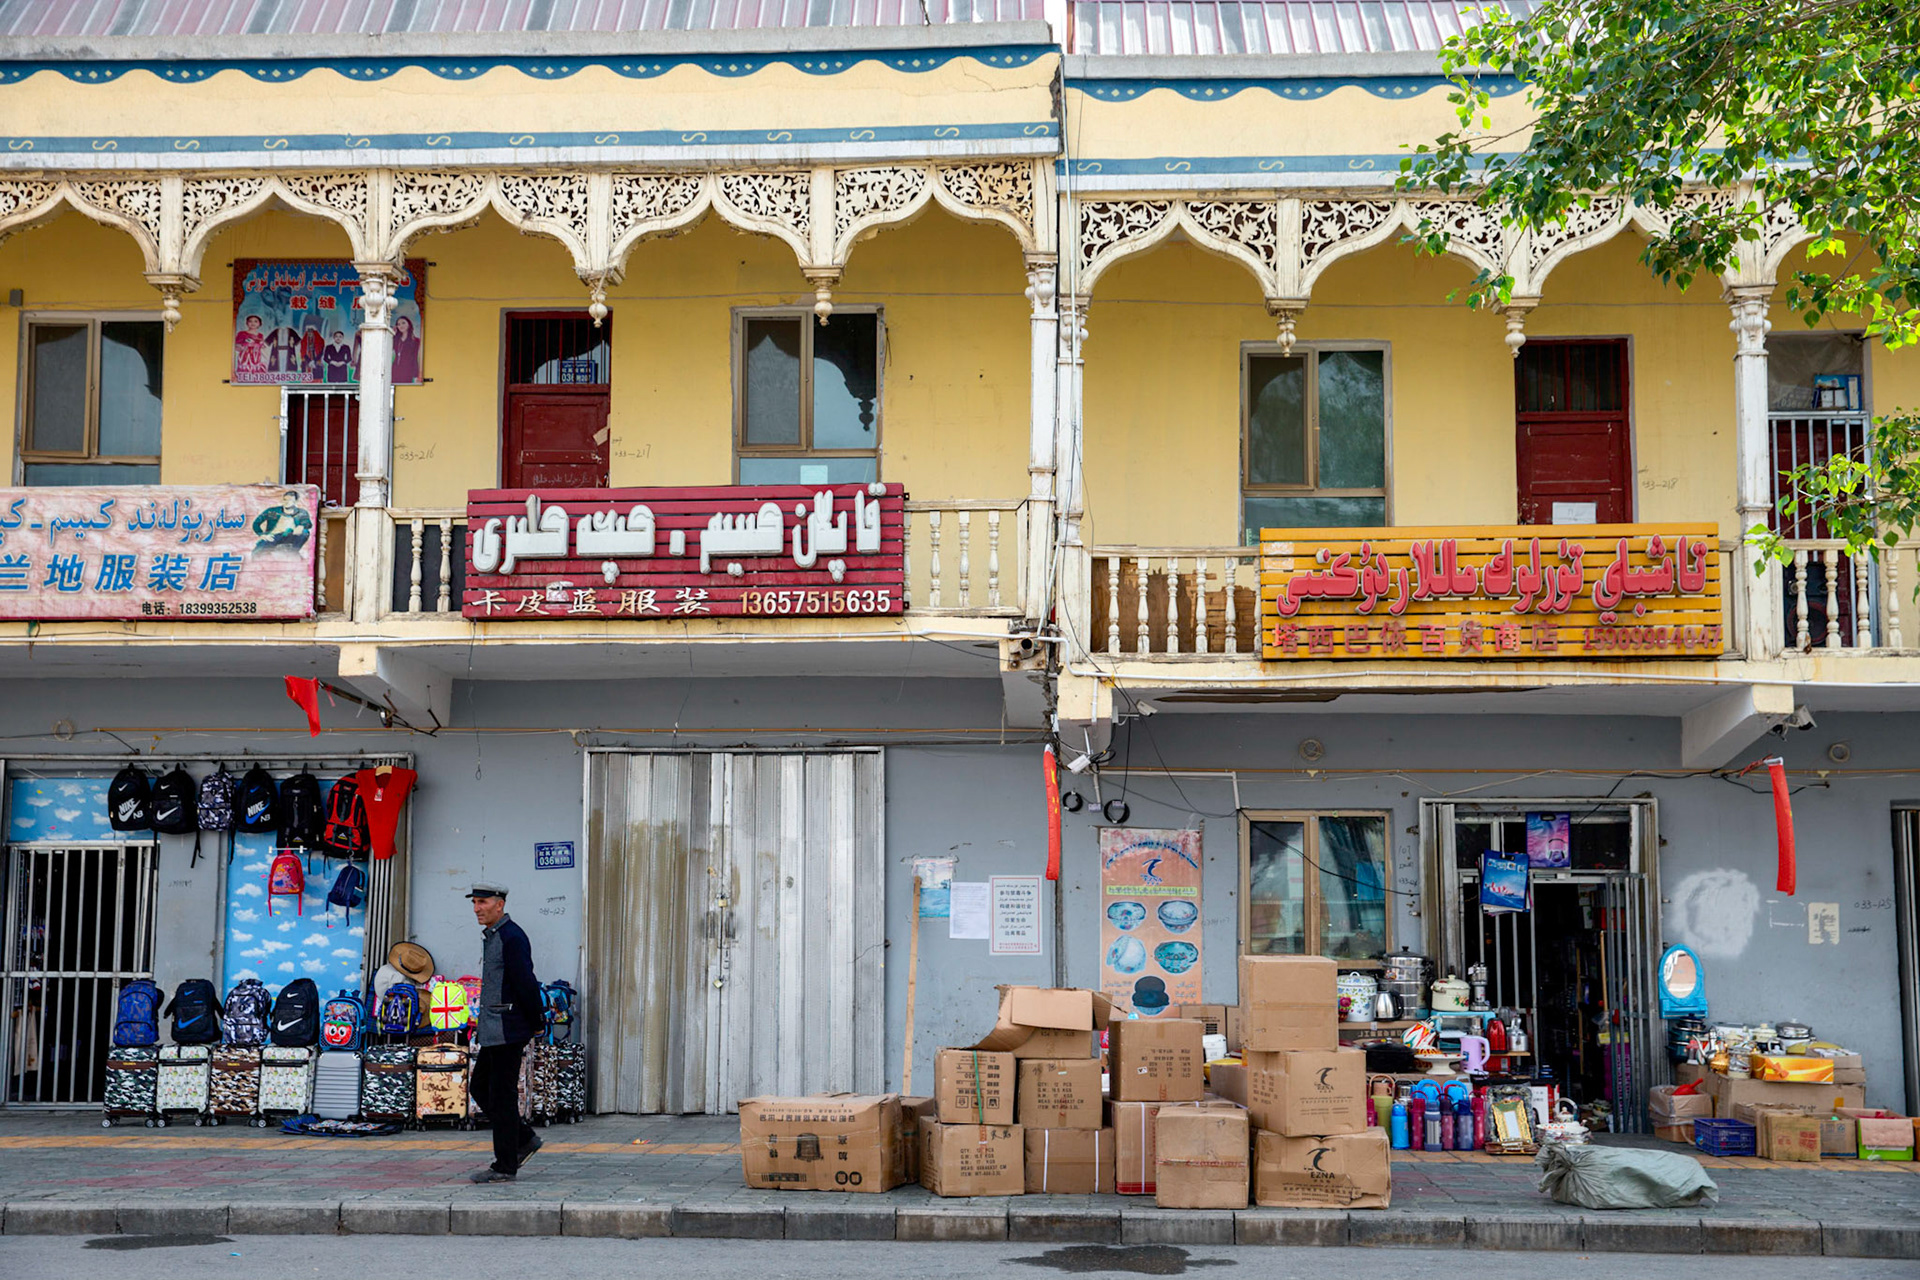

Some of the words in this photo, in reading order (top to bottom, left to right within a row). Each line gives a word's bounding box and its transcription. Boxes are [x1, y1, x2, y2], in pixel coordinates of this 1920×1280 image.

[178, 602, 258, 615] 18399352538
[472, 587, 711, 616] 卡皮蓝服装
[739, 589, 892, 614] 13657515635
[1271, 620, 1559, 654] 塔西巴依百货商店
[1582, 625, 1722, 651] 15909984047
[118, 797, 136, 815] NIKE
[247, 800, 266, 817] NIKE
[1310, 1171, 1336, 1179] EZNA
